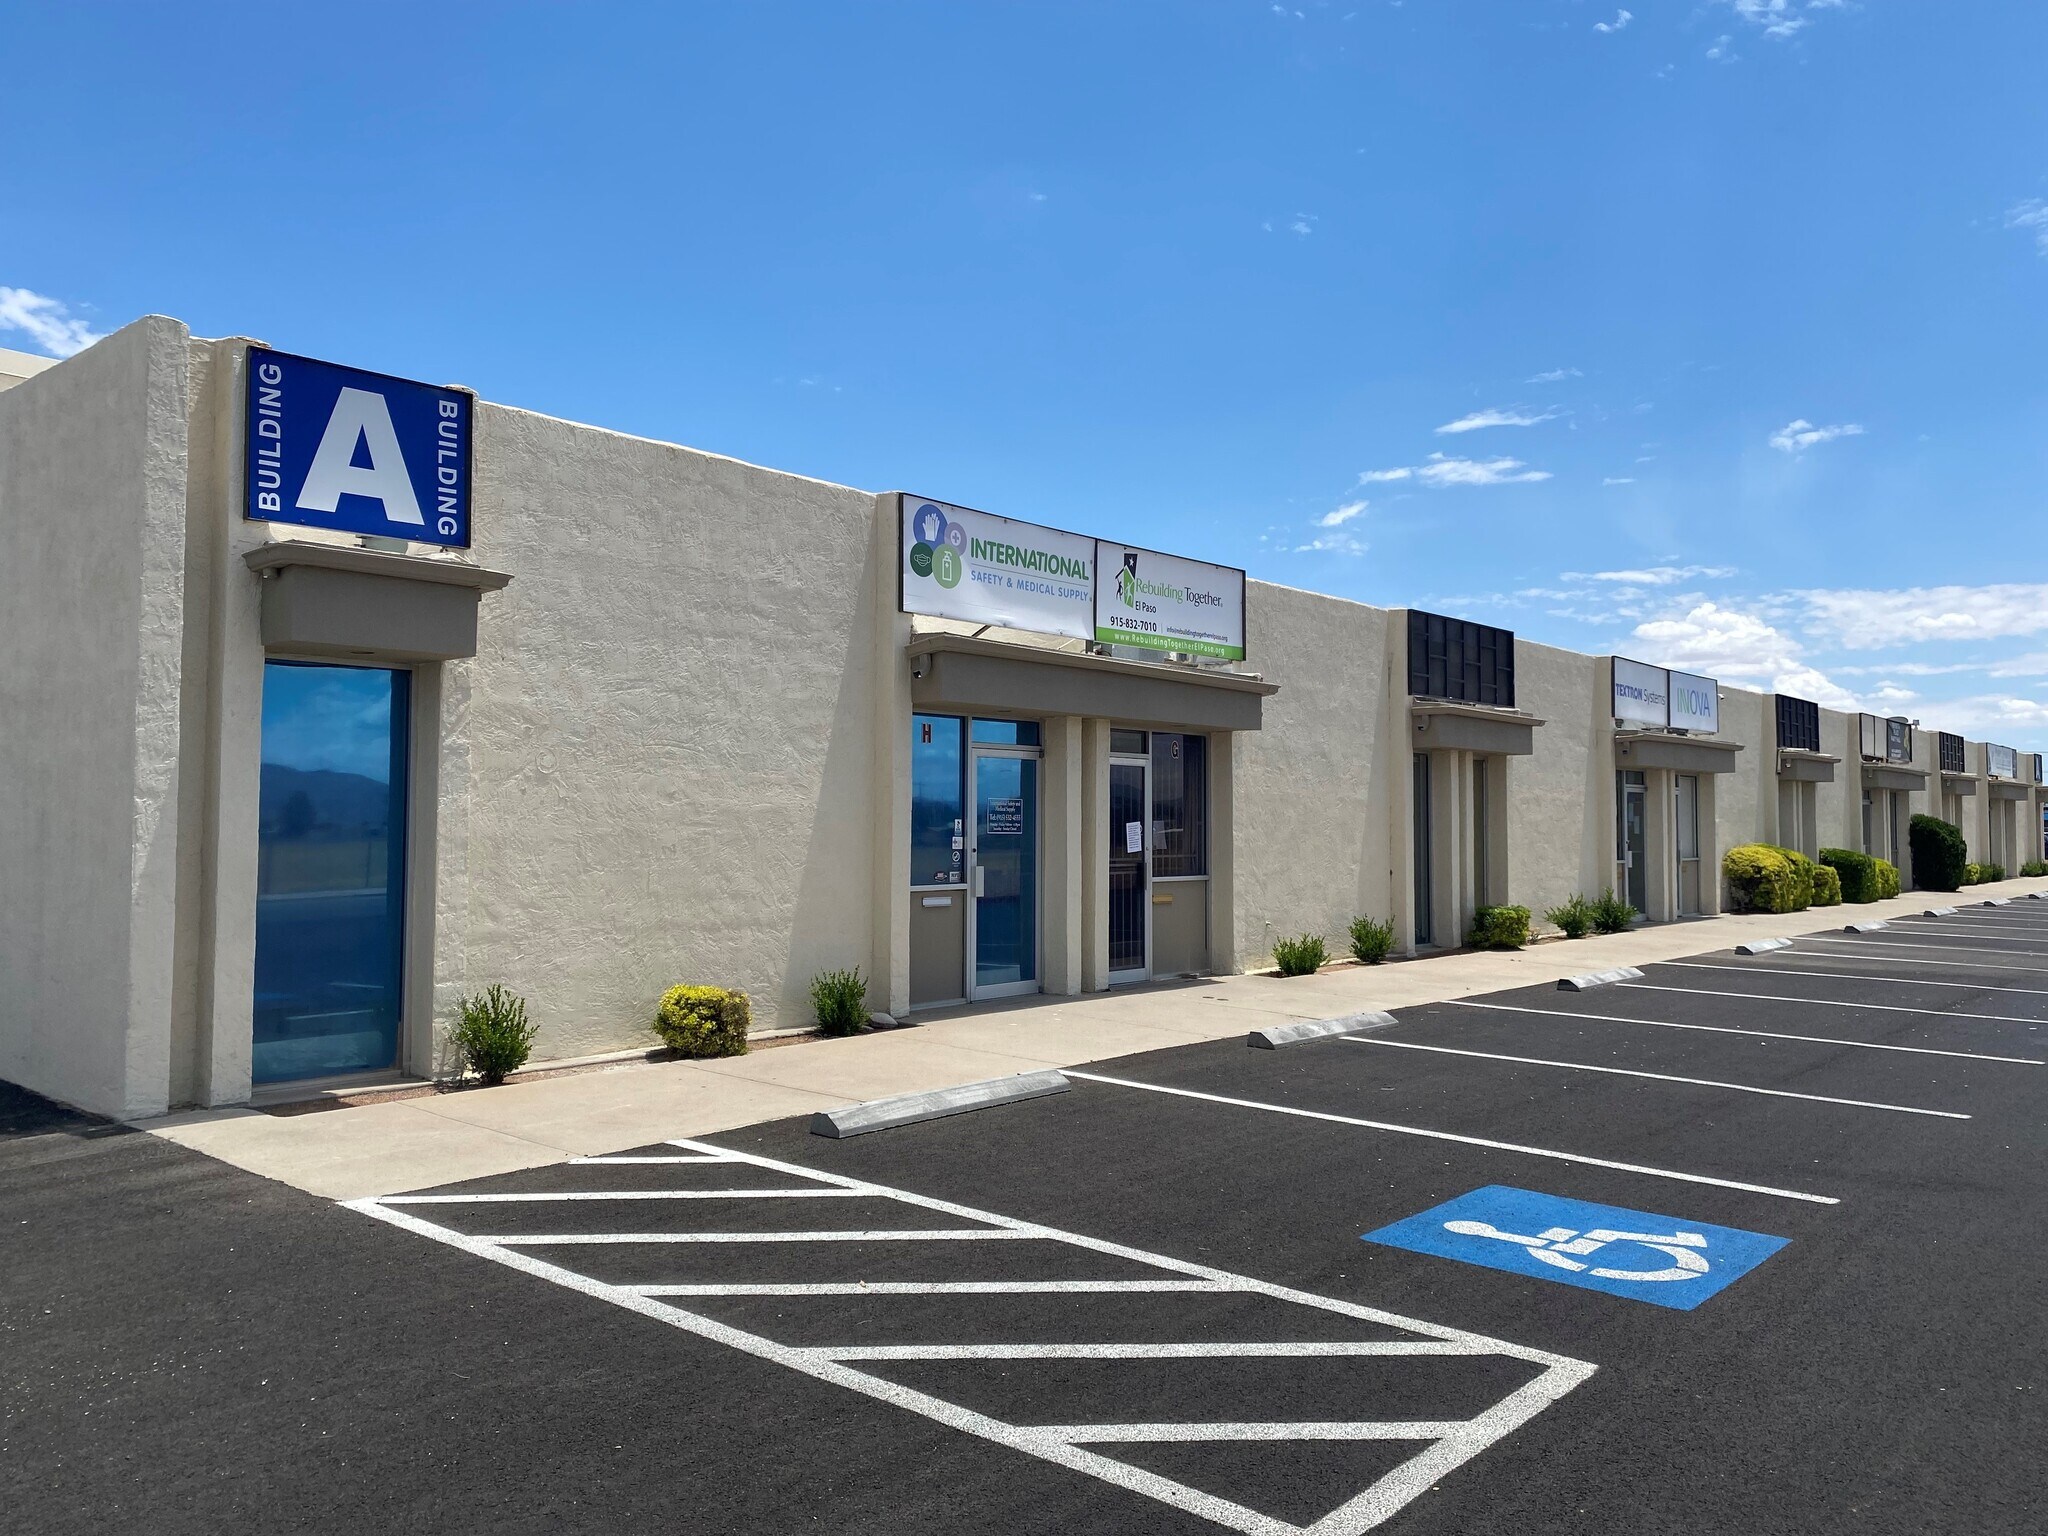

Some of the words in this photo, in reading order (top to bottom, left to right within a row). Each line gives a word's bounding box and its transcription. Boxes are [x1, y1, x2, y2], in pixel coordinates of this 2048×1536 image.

[258, 363, 282, 512] BUILDING
[295, 386, 425, 526] A
[437, 399, 458, 536] BUILDING
[970, 537, 1090, 581] INTERNATIONAL
[971, 570, 1003, 586] SAFETY
[1006, 577, 1013, 589] &
[1016, 578, 1055, 596] MEDICAL
[1058, 586, 1089, 602] SUPPLY
[1135, 577, 1184, 605] Rebuilding
[1135, 600, 1141, 611] El
[1141, 601, 1157, 614] Paso
[1110, 615, 1157, 632] 915-832-7010
[1114, 633, 1226, 656] www.RebuildingTogetherElPaso.org
[1616, 683, 1642, 700] TEXTRON
[1643, 689, 1666, 705] Systems
[921, 722, 932, 744] H
[1171, 740, 1179, 760] G
